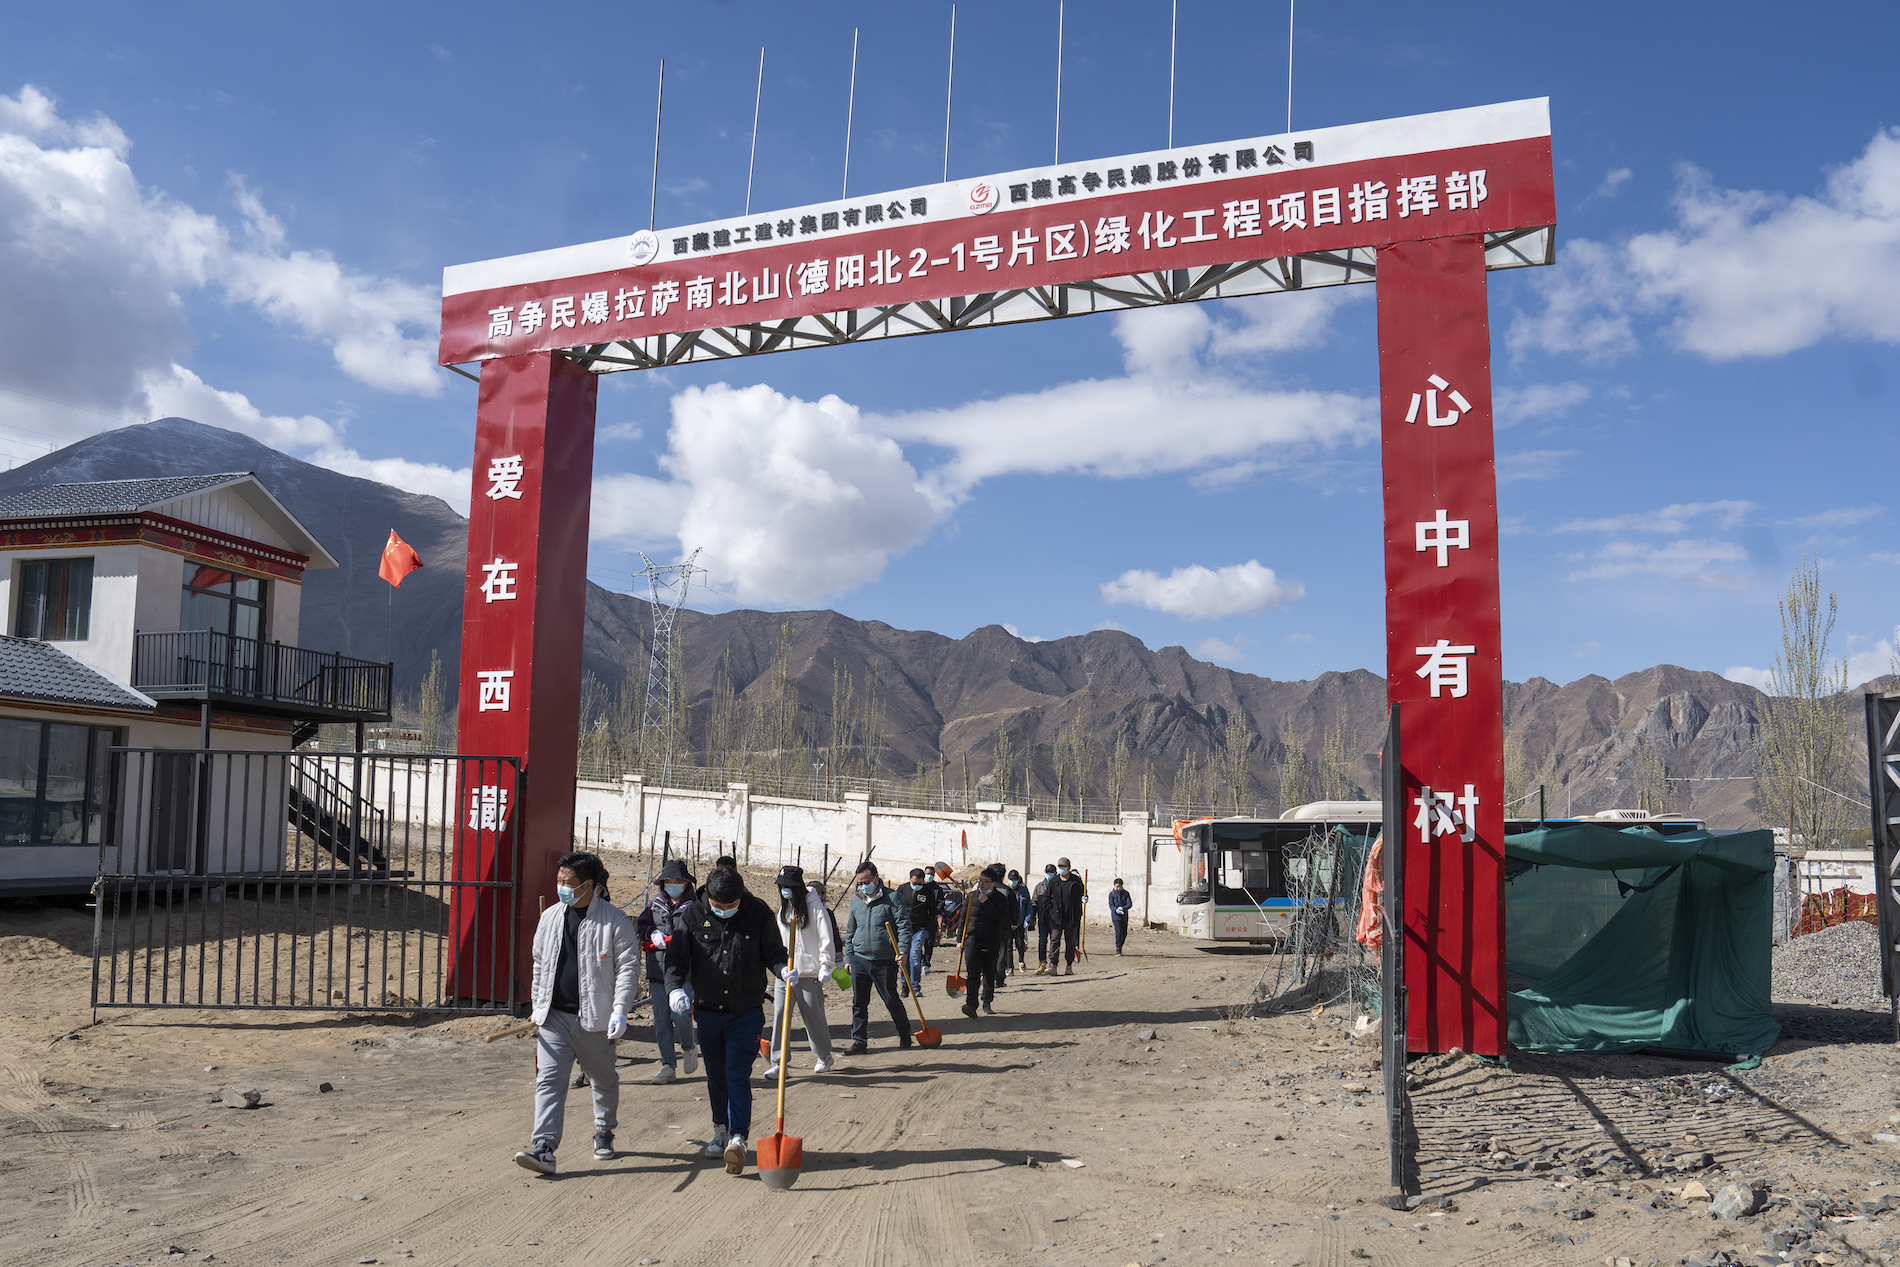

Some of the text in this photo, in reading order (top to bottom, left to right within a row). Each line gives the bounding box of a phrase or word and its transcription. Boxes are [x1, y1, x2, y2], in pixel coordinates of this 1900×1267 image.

[1009, 140, 1315, 203] 西藏高争民爆股份有限公司
[672, 197, 928, 255] 西藏建工建材集团有限公司
[970, 202, 992, 210] GZMB
[1404, 373, 1480, 844] 心中有树
[468, 454, 525, 833] 爱在西藏
